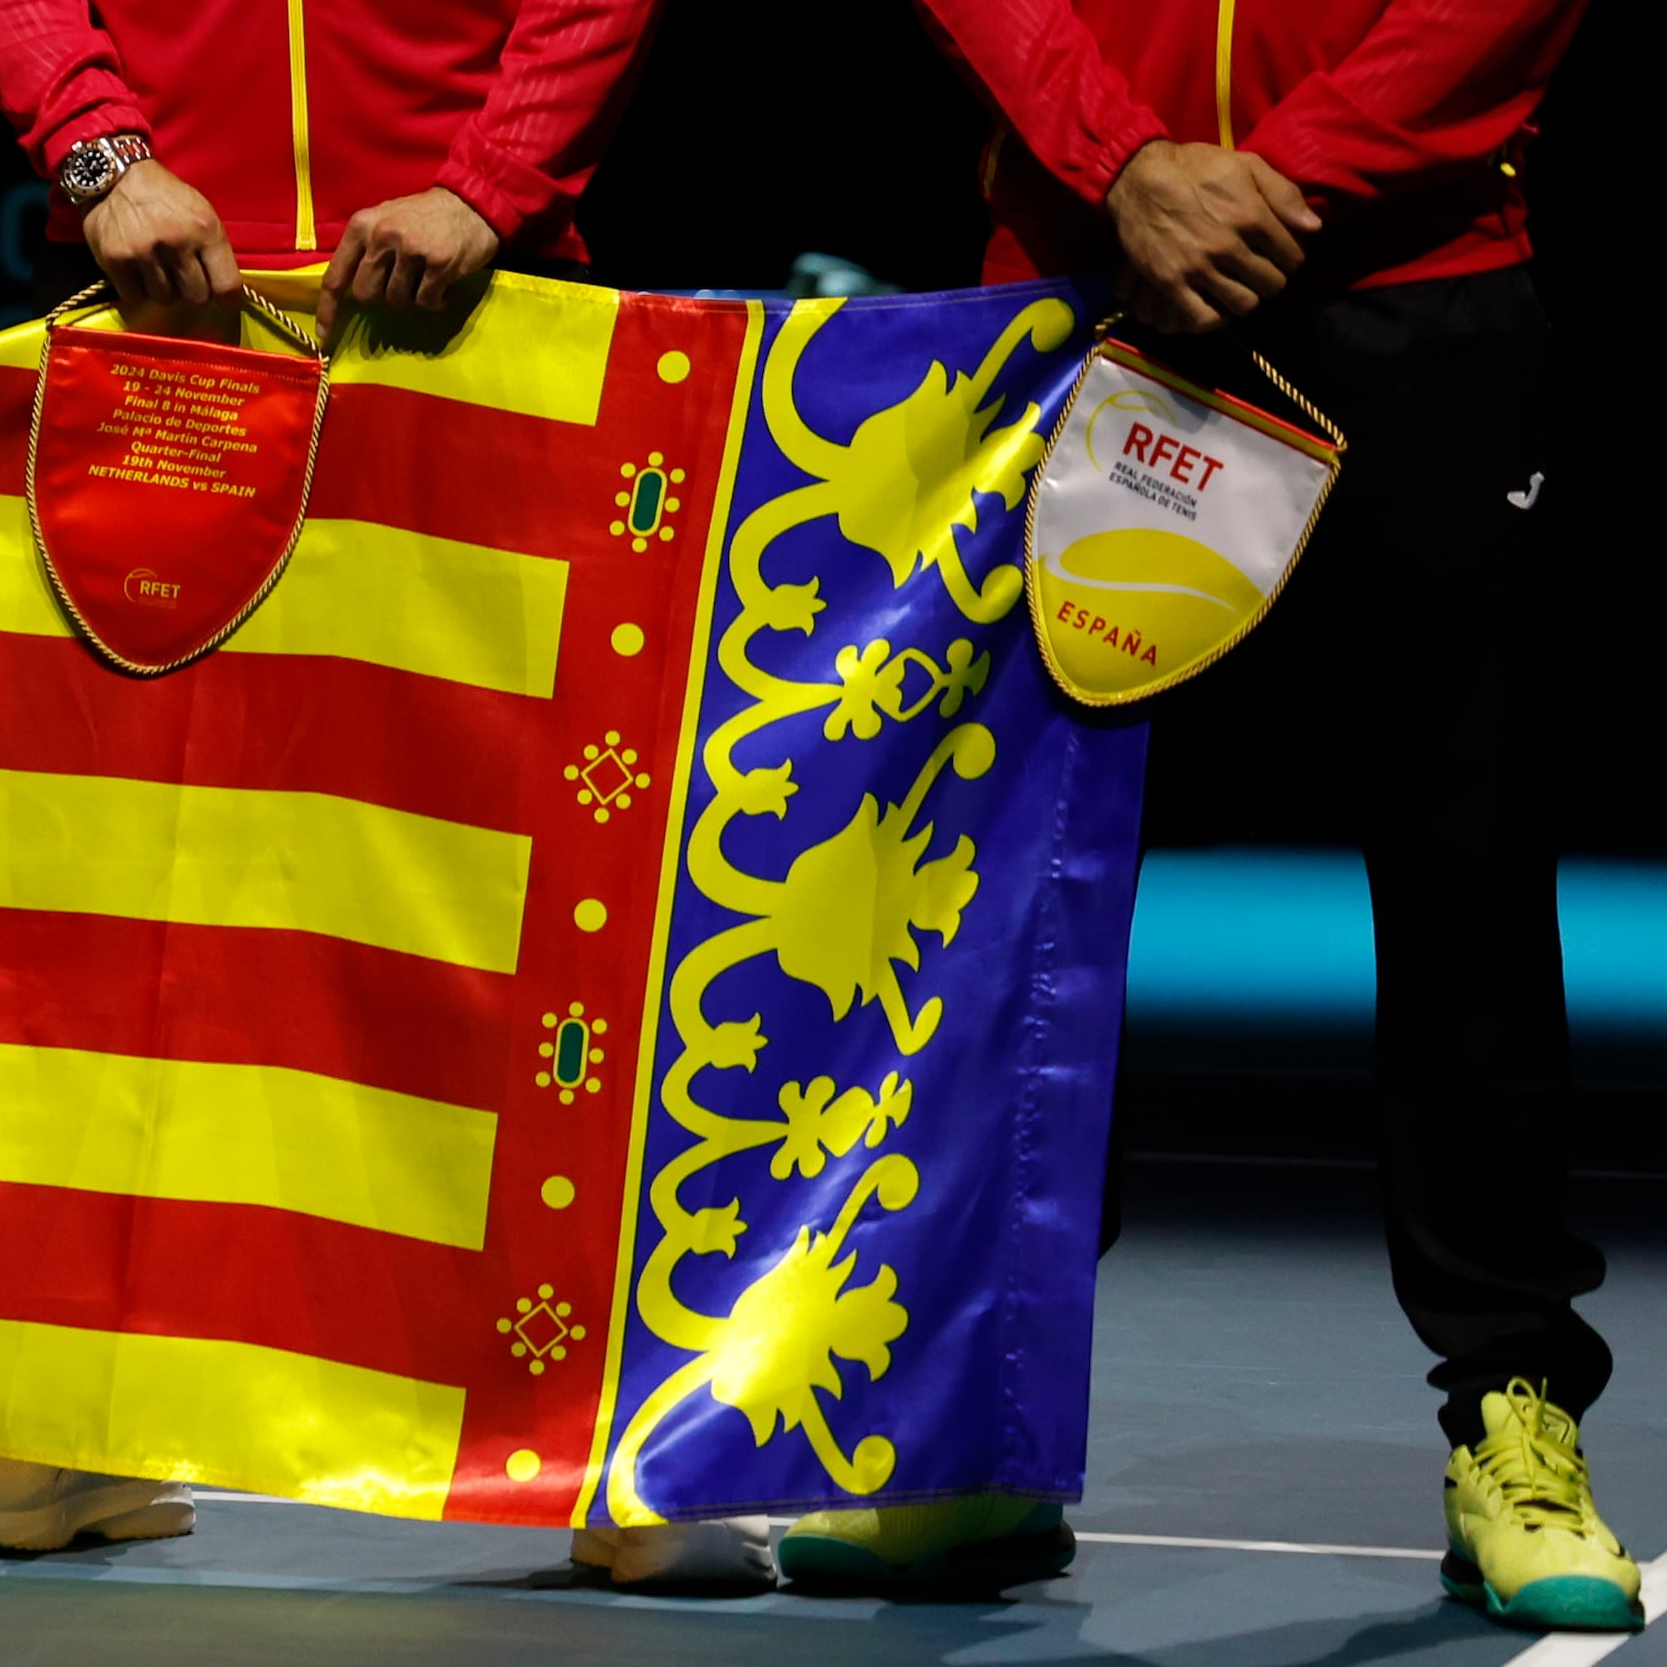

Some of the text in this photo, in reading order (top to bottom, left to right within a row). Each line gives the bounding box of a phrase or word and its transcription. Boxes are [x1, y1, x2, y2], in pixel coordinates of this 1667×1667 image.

[110, 363, 260, 394] 2024 Davis Cup Finals
[123, 381, 141, 392] 19
[154, 385, 171, 396] 24
[175, 387, 245, 407] November
[124, 395, 239, 422] Final 8 in Málaga
[113, 408, 247, 437] Palacio de Deportes
[97, 422, 129, 435] José
[201, 435, 258, 453] Carpena
[131, 440, 221, 463] Quarter-Final
[122, 454, 227, 479] 19th November
[1114, 461, 1138, 480] REAL
[1123, 421, 1224, 492] RFET
[88, 464, 256, 498] NETHERLANDS vs SPAIN
[1108, 472, 1156, 501] ESPAÑOLA
[1172, 501, 1197, 522] TENIS
[140, 580, 181, 599] RFET
[1057, 600, 1157, 667] ESPAÑA
